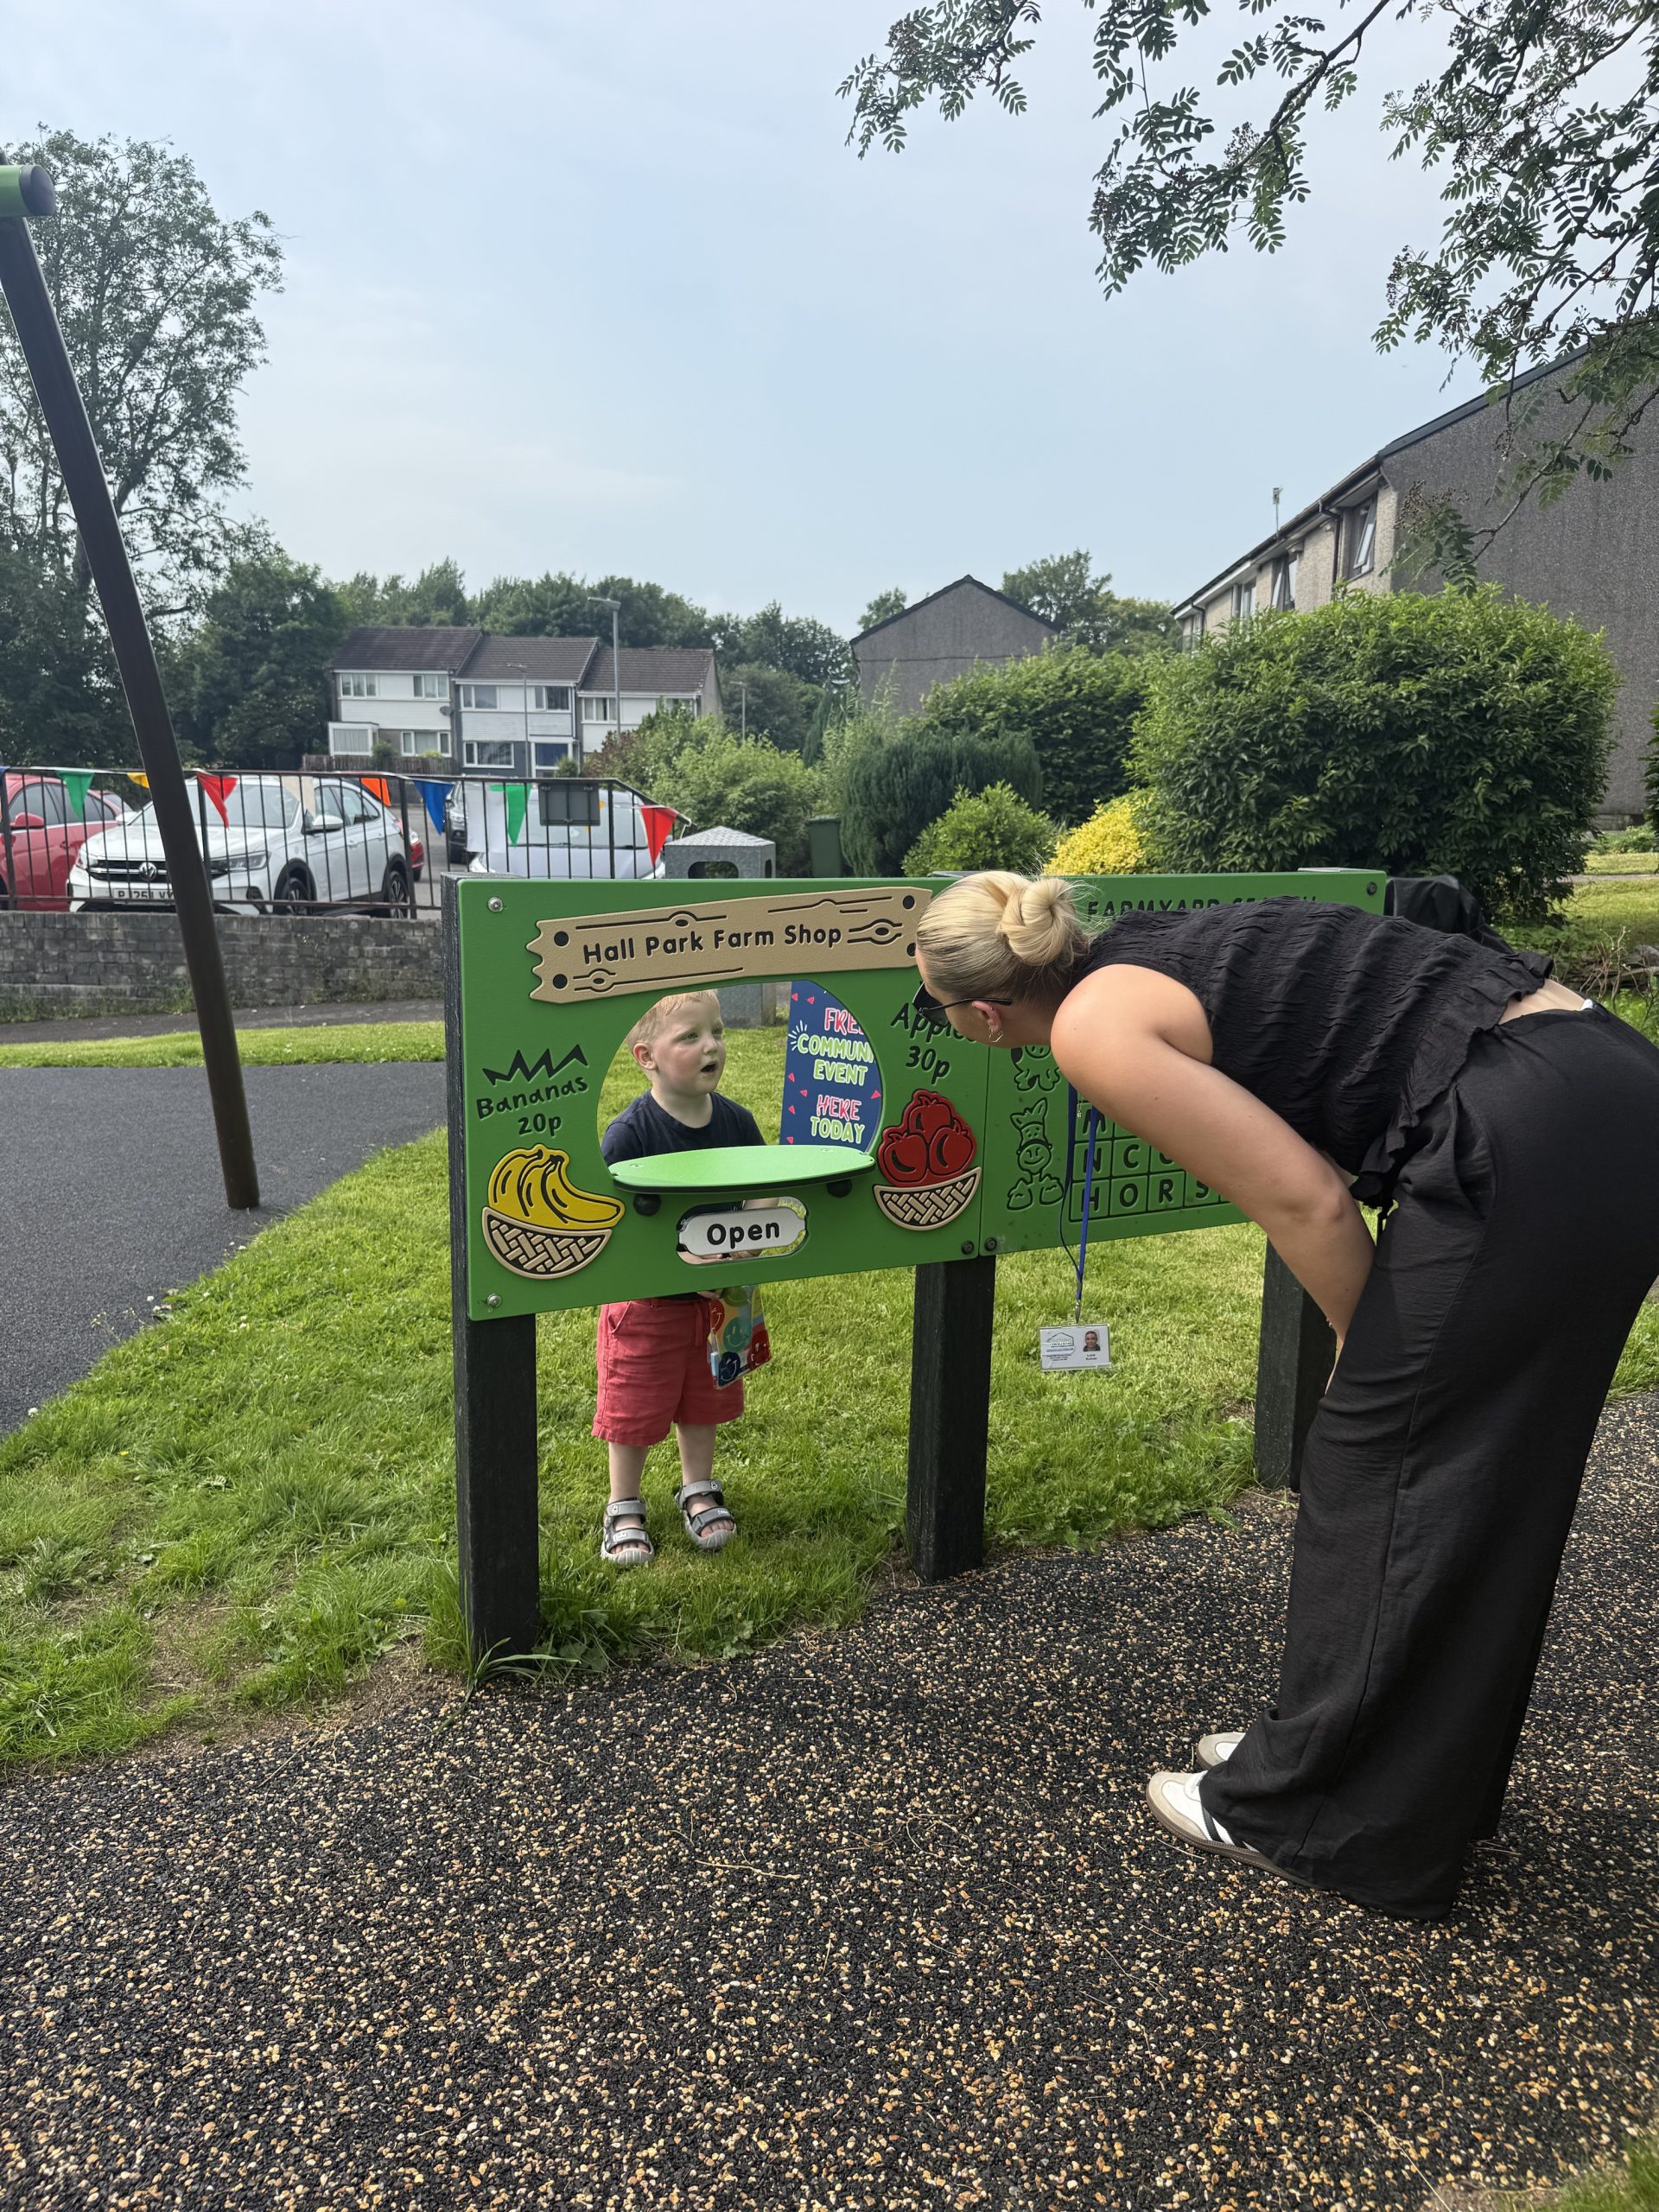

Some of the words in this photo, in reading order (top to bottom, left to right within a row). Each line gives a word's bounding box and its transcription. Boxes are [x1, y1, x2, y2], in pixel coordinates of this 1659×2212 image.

[583, 937, 635, 964] Hall
[645, 931, 703, 957] Park
[714, 930, 774, 950] Farm
[784, 924, 842, 948] Shop
[824, 1007, 864, 1035] FRE
[890, 1003, 976, 1043] Appl
[813, 1059, 868, 1086] EVENT
[906, 1046, 950, 1085] 30p
[476, 1077, 588, 1120] Bananas
[817, 1095, 861, 1121] HERE
[518, 1113, 562, 1138] 20p
[810, 1116, 865, 1143] TODAY
[1123, 1144, 1140, 1168] C
[707, 1222, 780, 1249] Open
